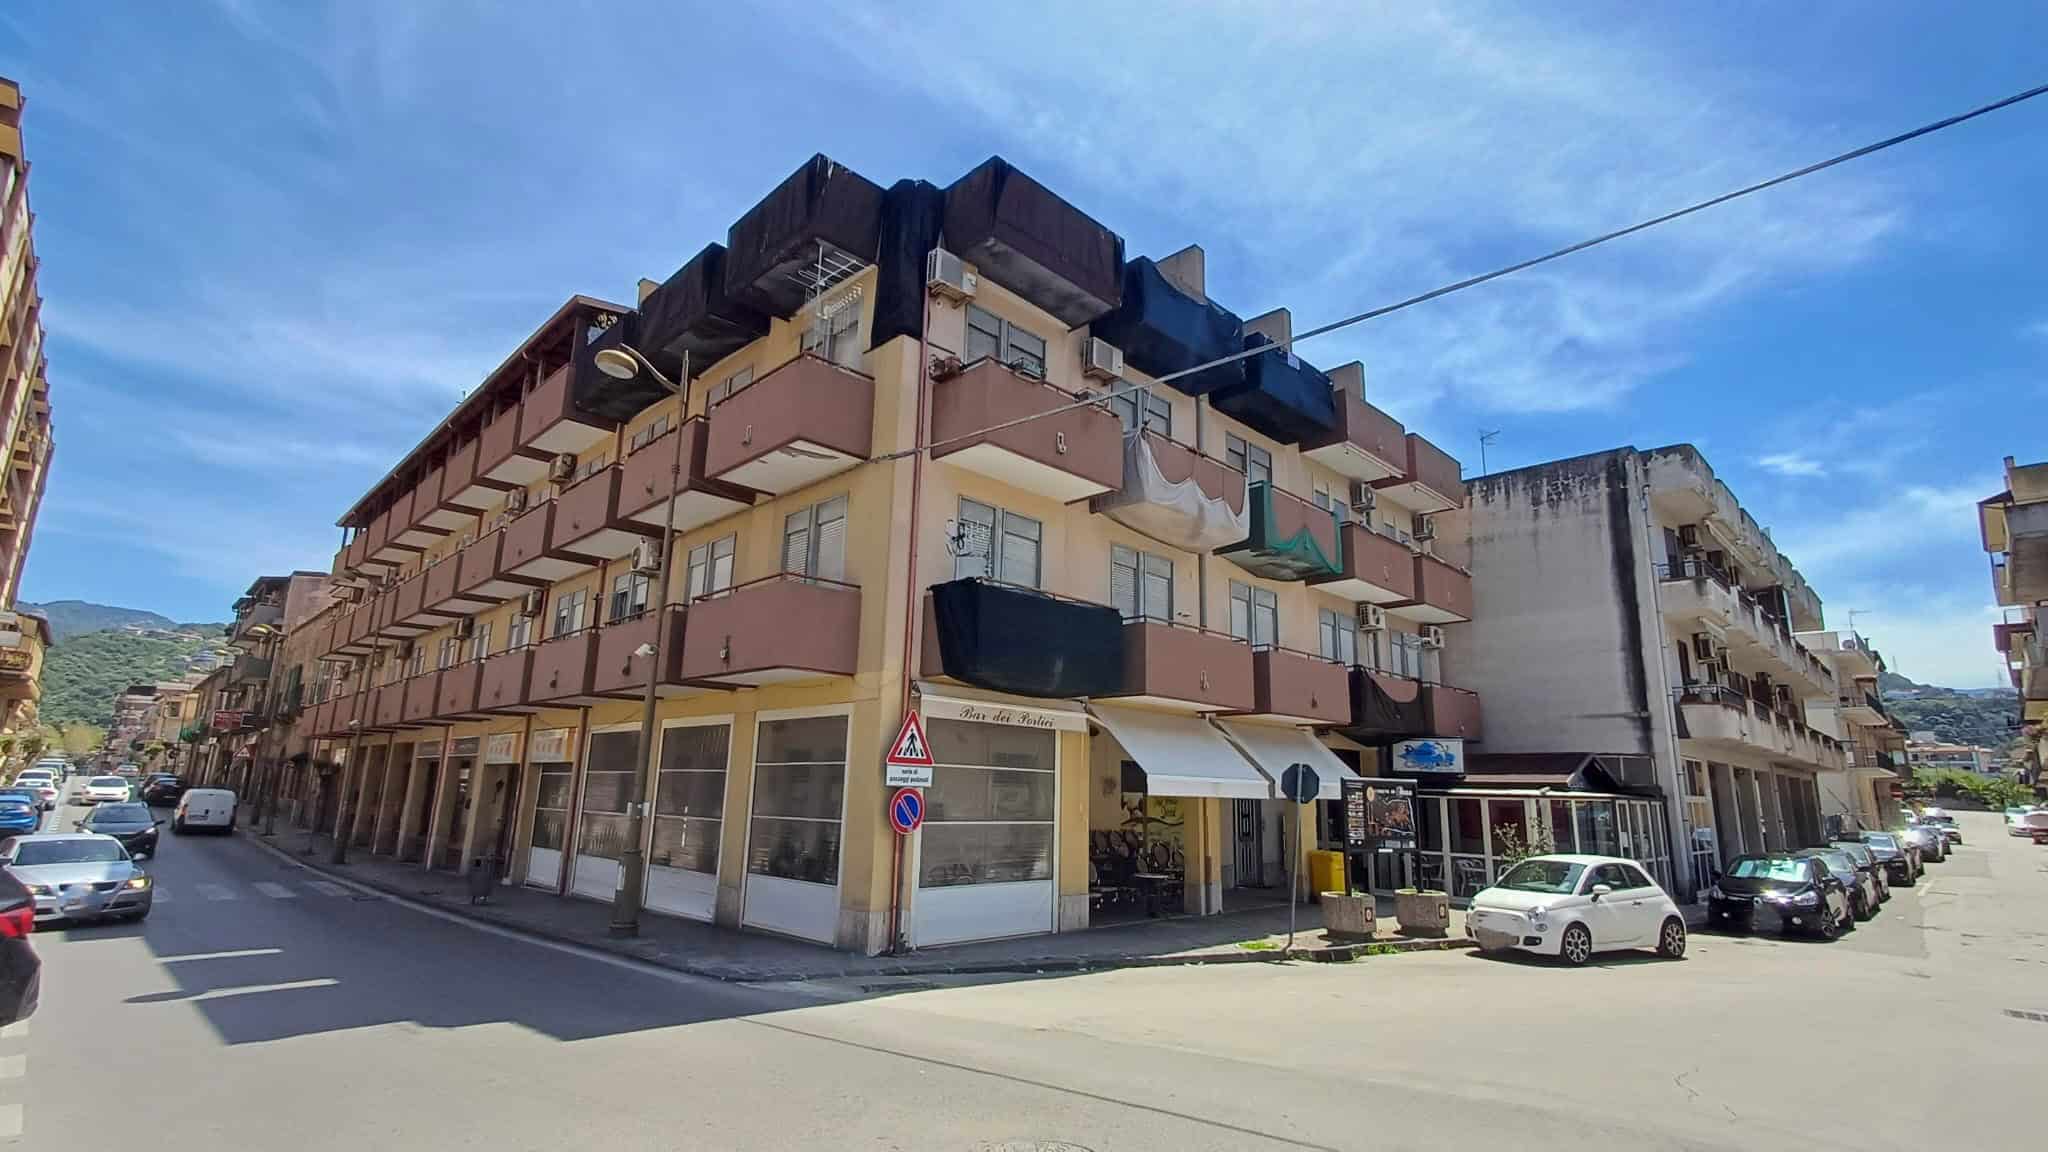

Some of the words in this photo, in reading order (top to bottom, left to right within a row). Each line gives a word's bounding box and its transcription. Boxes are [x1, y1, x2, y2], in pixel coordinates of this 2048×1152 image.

[960, 705, 986, 720] Bar
[993, 710, 1011, 723] dei
[1017, 711, 1055, 727] Portici
